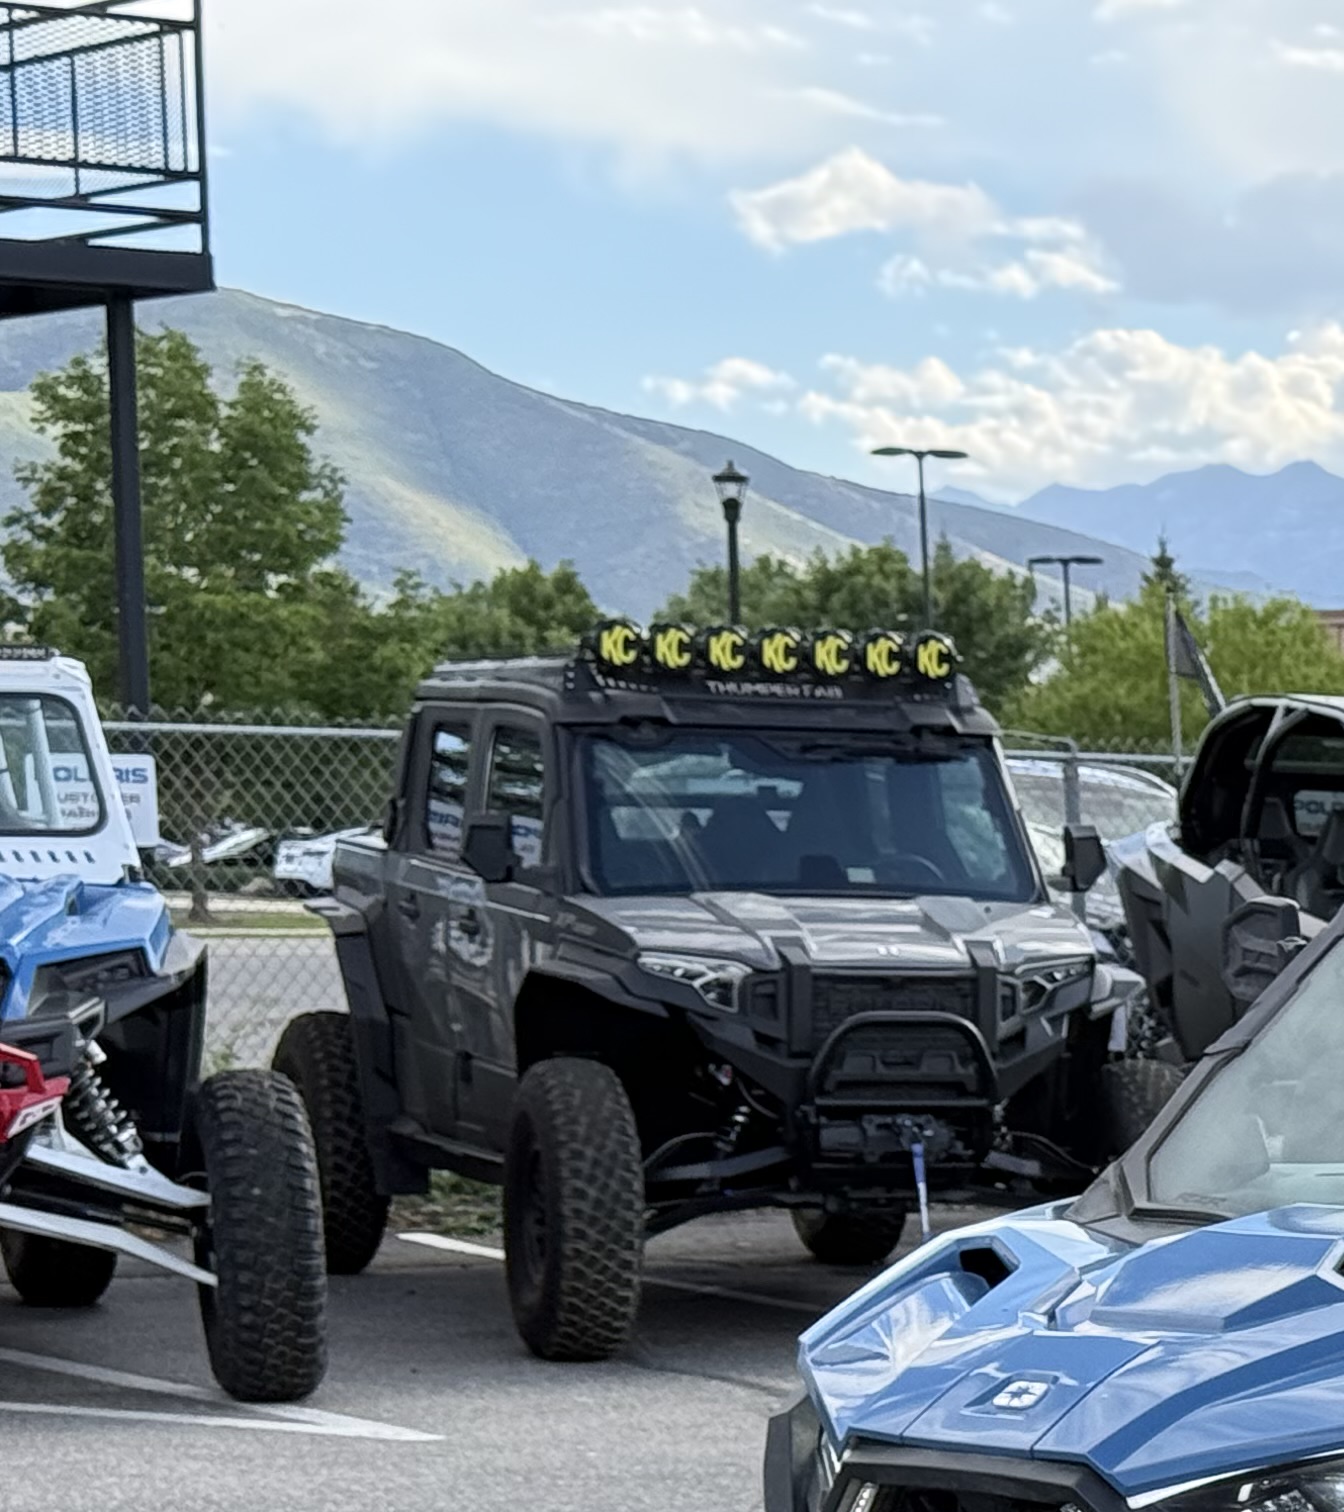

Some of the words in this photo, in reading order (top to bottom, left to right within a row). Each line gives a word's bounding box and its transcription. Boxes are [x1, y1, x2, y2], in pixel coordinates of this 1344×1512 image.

[602, 625, 637, 666] KC
[656, 628, 691, 669] KC
[709, 630, 744, 671] KC
[762, 632, 797, 673] KC
[815, 635, 849, 675] KC
[866, 637, 900, 677] KC
[917, 639, 949, 679] KC
